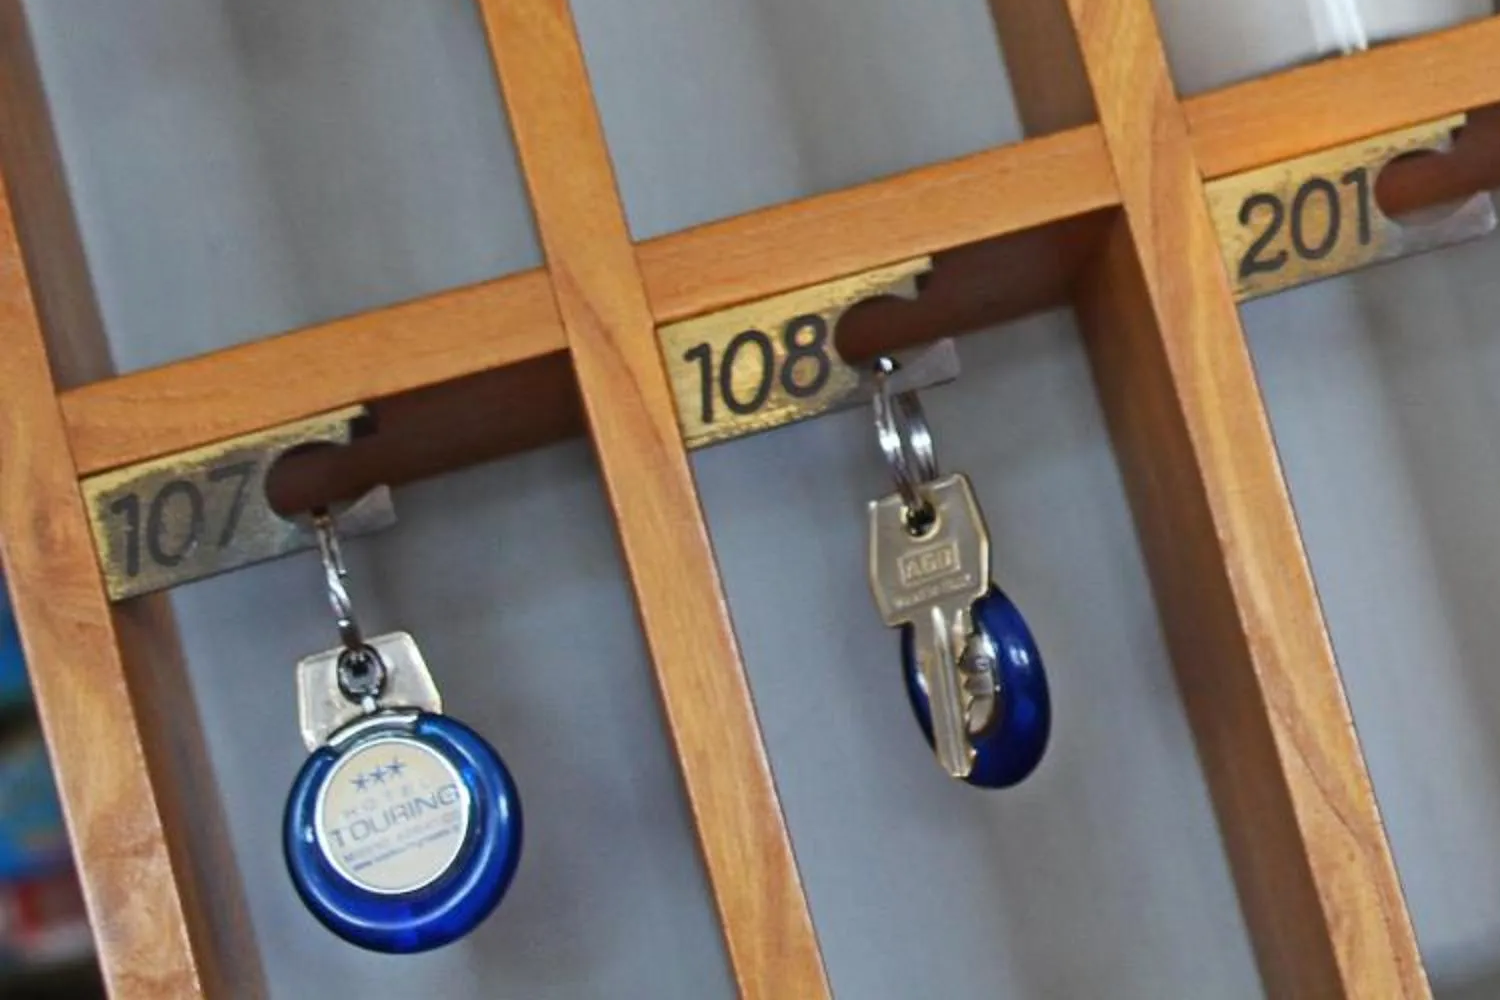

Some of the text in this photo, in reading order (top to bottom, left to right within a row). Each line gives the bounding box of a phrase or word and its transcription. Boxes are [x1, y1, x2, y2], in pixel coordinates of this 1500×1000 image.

[1237, 166, 1371, 280] 201
[682, 312, 832, 424] 108
[110, 459, 258, 578] 107
[328, 782, 461, 849] TOURING
